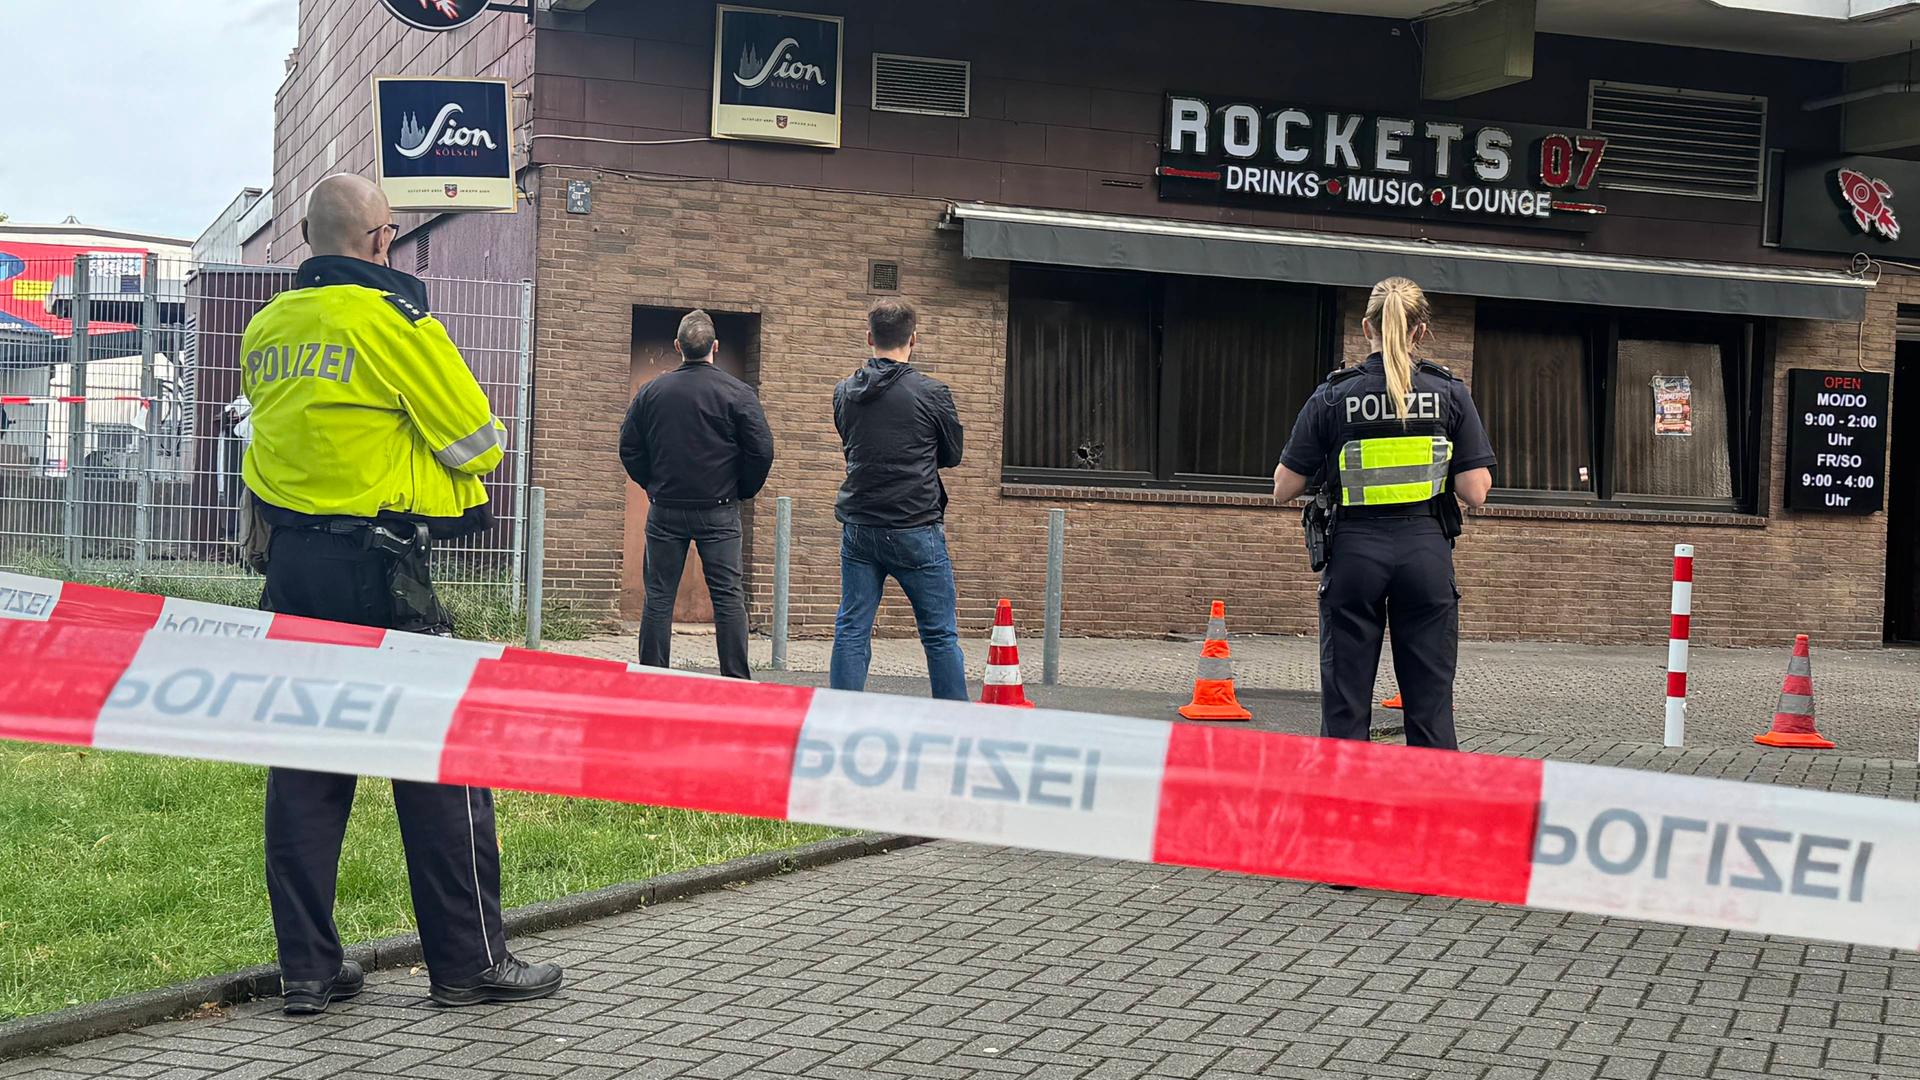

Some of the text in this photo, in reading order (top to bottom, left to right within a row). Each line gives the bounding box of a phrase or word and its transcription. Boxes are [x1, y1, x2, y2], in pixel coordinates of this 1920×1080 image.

[733, 37, 827, 89] Sion
[394, 102, 498, 160] Sion
[1168, 96, 1609, 189] ROCKETS 07
[435, 147, 479, 157] KÖLSCH
[1226, 165, 1551, 217] DRINKS MUSIC LOUNGE
[246, 342, 356, 385] POLIZEI
[1824, 376, 1862, 389] OPEN
[1817, 393, 1867, 408] MO/DO
[1804, 412, 1835, 427] 9:00
[1847, 414, 1877, 428] 2:00
[1828, 432, 1854, 446] Uhr
[1817, 453, 1862, 468] FR/SO
[1802, 473, 1832, 487] 9:00
[1844, 475, 1874, 489] 4:00
[1825, 493, 1851, 507] Uhr
